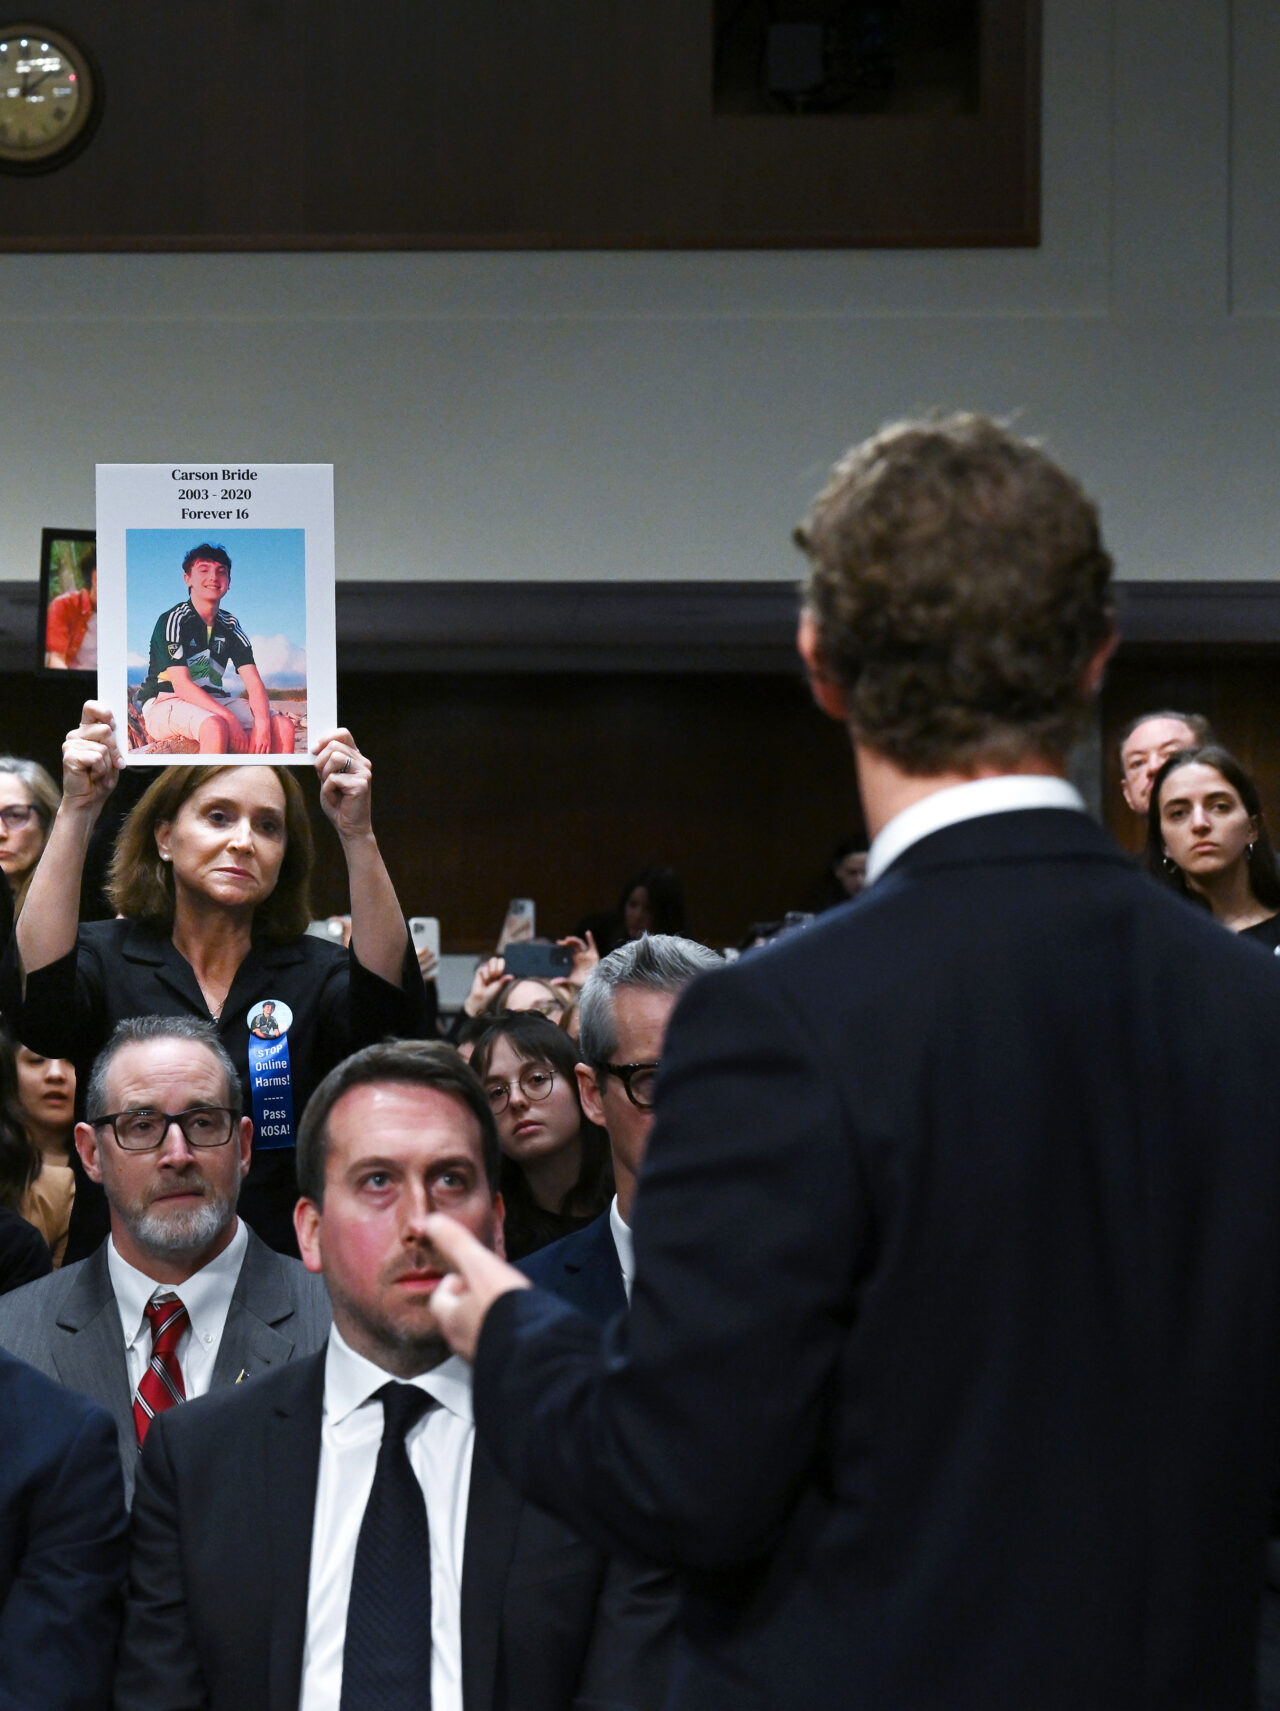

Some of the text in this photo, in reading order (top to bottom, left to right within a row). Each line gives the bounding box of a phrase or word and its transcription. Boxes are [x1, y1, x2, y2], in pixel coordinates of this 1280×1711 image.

[171, 469, 258, 481] Carson Bride
[178, 488, 209, 500] 2003
[220, 488, 252, 500] 2020
[181, 508, 249, 520] Forever 16
[257, 1044, 283, 1058] STOP
[255, 1059, 287, 1072] Online
[255, 1075, 290, 1088] Harms!
[263, 1109, 286, 1120] Pass
[260, 1125, 291, 1137] KOSA!
